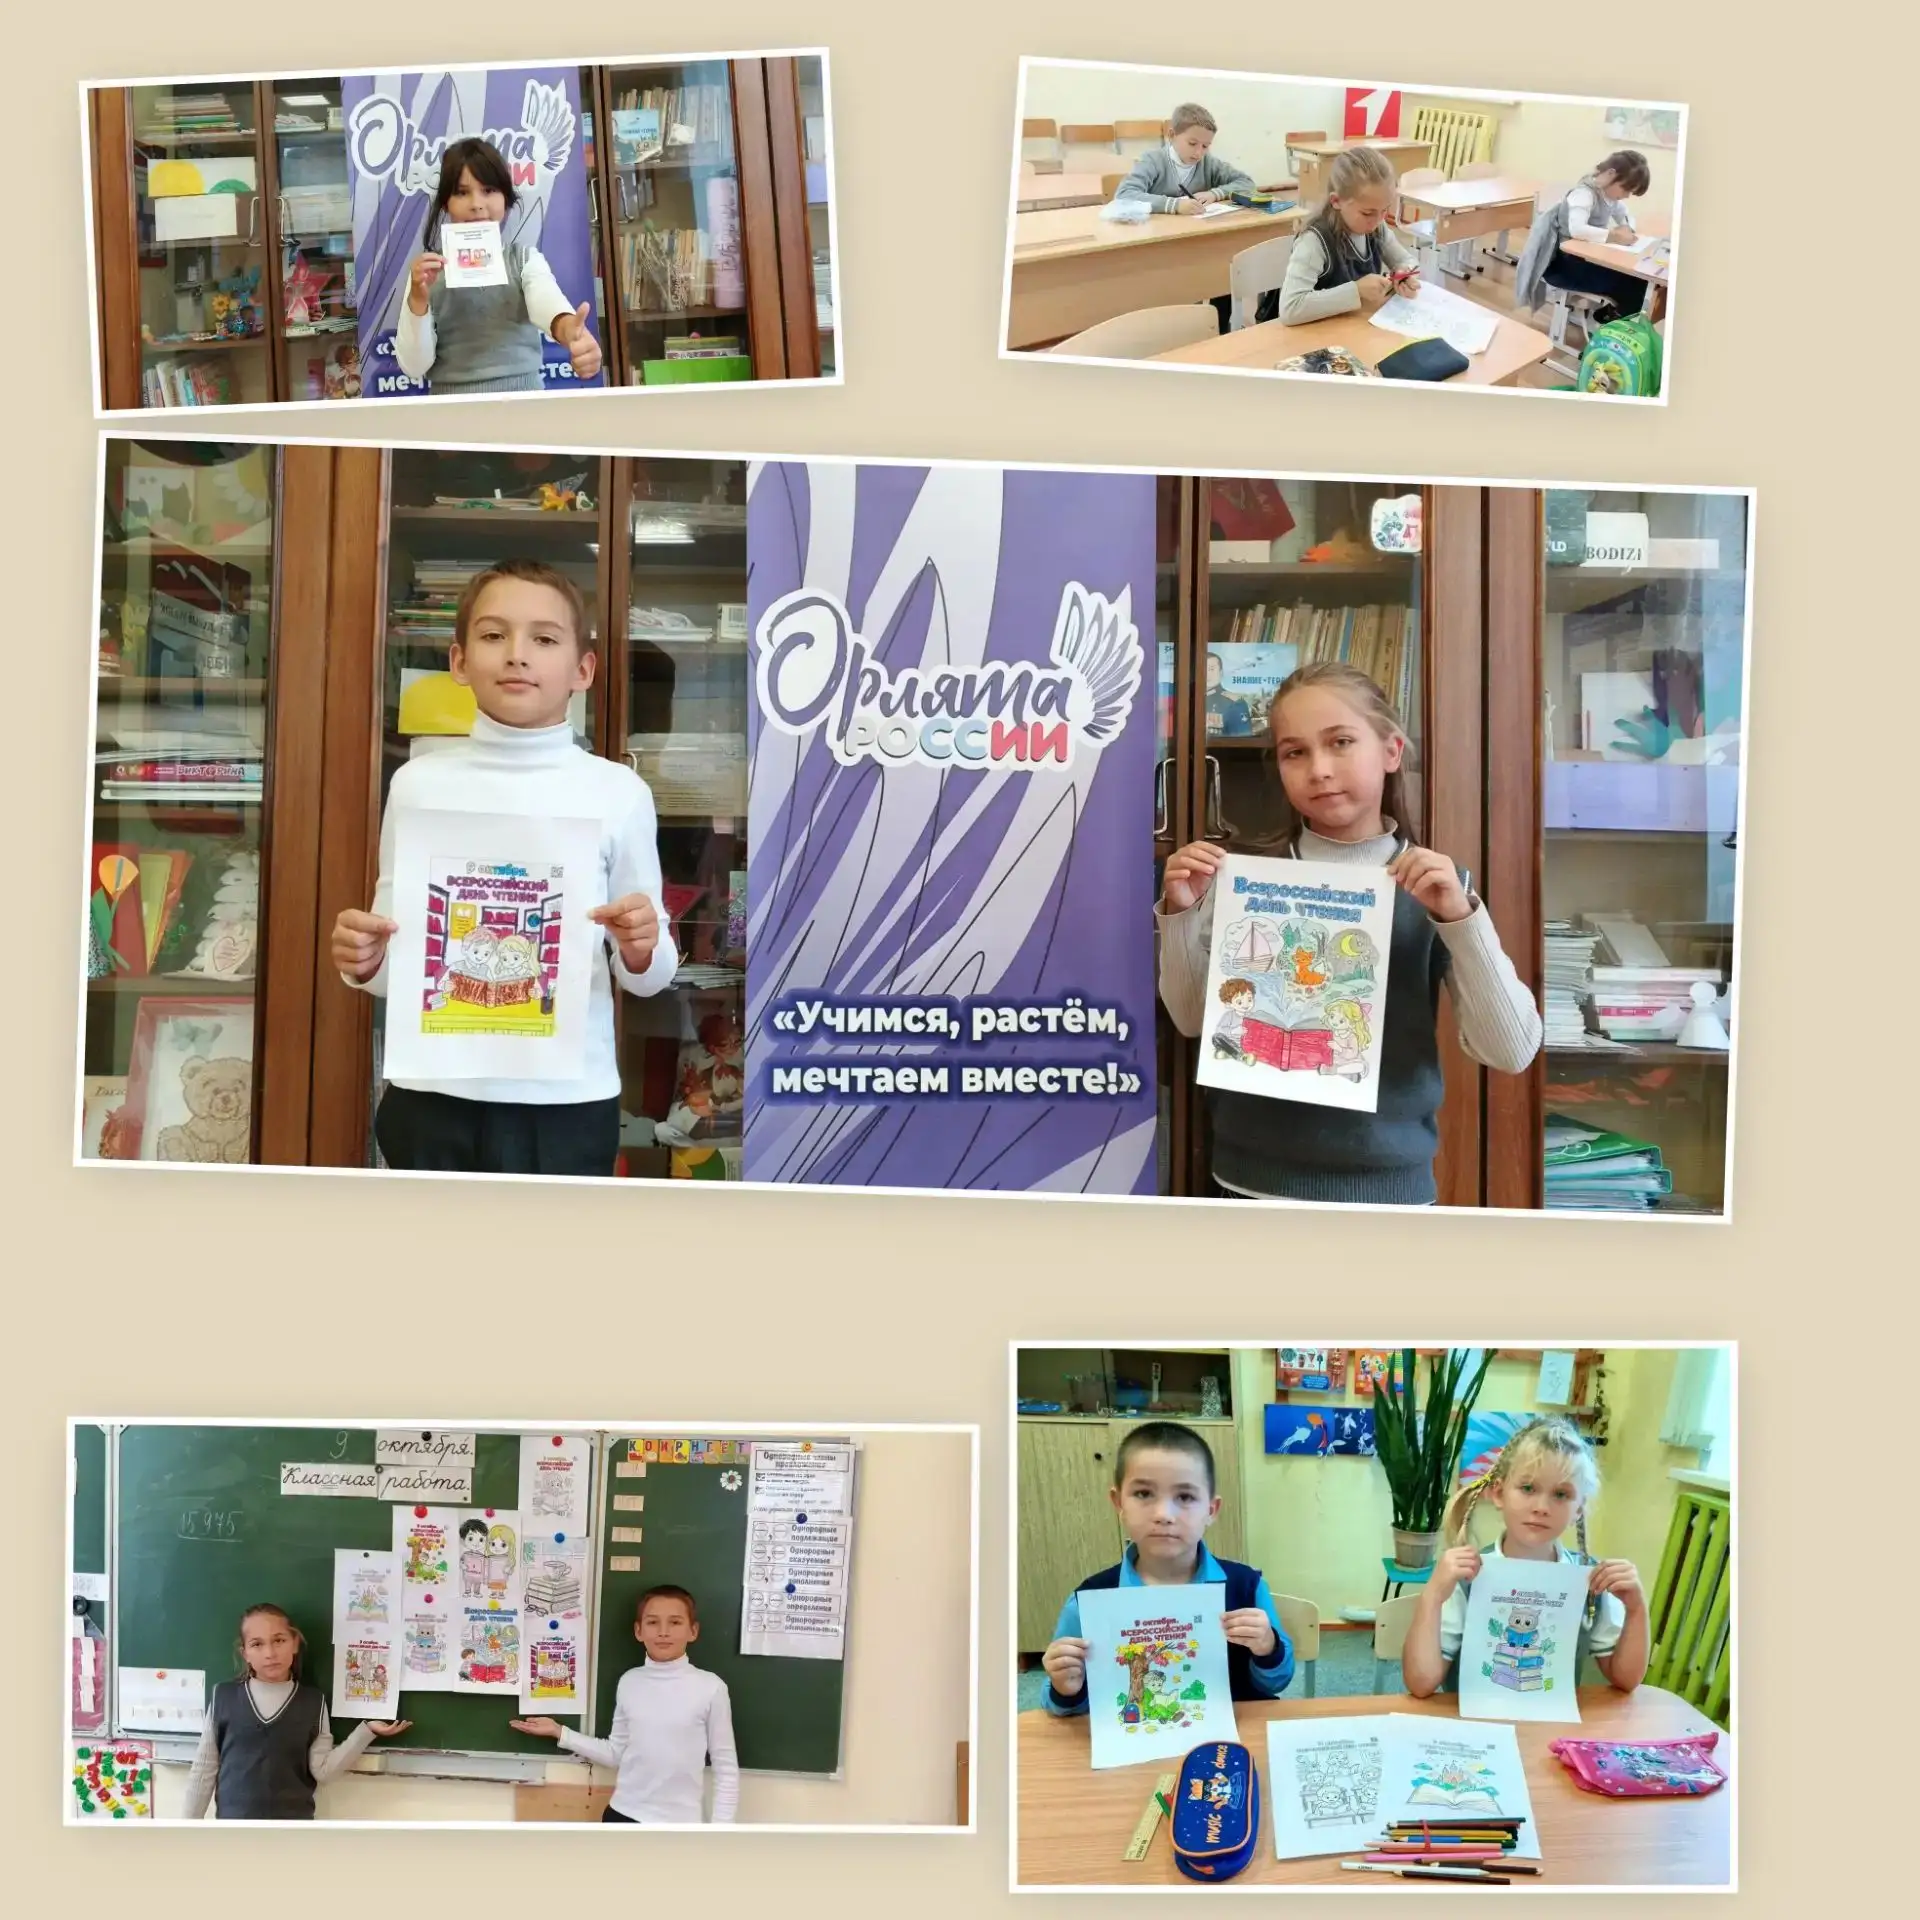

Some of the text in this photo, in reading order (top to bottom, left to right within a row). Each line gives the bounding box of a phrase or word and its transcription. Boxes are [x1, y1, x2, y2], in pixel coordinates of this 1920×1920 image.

[767, 596, 1072, 741] Орлята
[447, 875, 549, 893] ВСЕРОССИЙСКИЙ
[1233, 877, 1376, 908] Всероссийский
[457, 890, 538, 903] ДЕНЬ ЧТЕНИЯ
[1295, 903, 1362, 923] чтения
[773, 998, 1128, 1041] «Учимся, растём,
[773, 1062, 1141, 1096] мечтаем вместе!»
[329, 1431, 348, 1459] 9
[283, 1467, 376, 1487] Классная
[791, 1524, 837, 1534] Однородные
[1121, 1623, 1193, 1637] ВСЕРОССИЙСКИЙ
